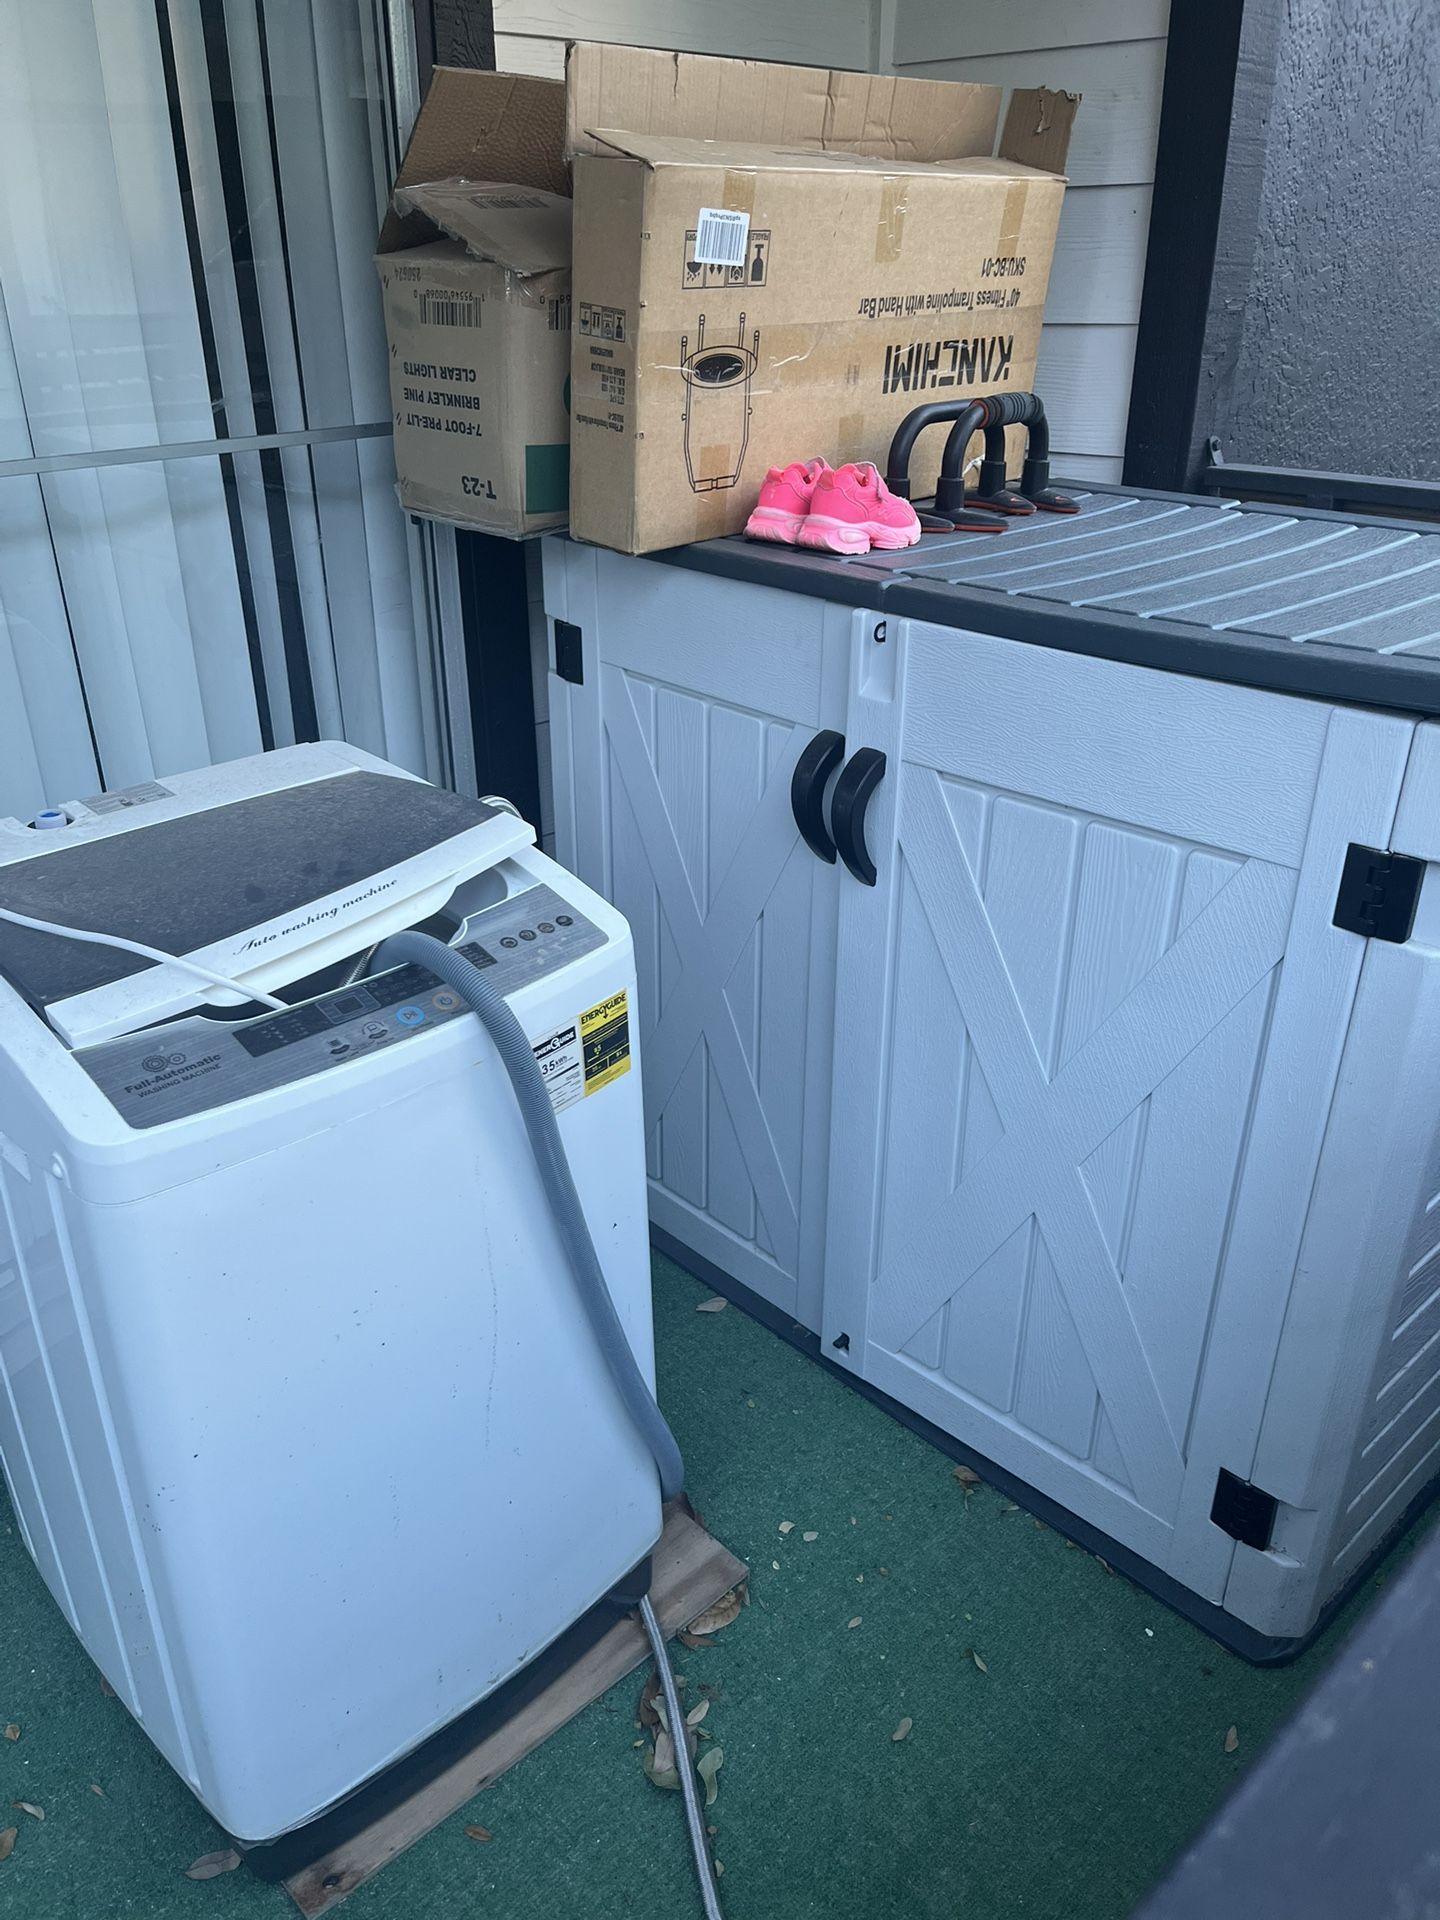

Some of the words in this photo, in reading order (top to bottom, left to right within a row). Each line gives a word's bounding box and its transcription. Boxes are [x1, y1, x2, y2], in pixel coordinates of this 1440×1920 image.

[981, 256, 1026, 277] SKU:BC-01
[858, 298, 877, 318] Bar
[878, 296, 905, 318] Hand
[905, 295, 925, 316] with
[926, 288, 975, 314] Trampoline
[976, 290, 1006, 308] Fitness
[403, 362, 437, 378] LIGHTS
[440, 366, 477, 382] CLEAR
[403, 387, 424, 402] PINE
[427, 391, 480, 410] BRINKLEY
[406, 413, 442, 430] PRE-LIT
[445, 419, 482, 437] 7-FOOT
[461, 475, 497, 500] T-23
[233, 935, 277, 955] Auto
[282, 906, 339, 936] washing
[342, 879, 398, 909] machine
[124, 1054, 222, 1093] Full-Automatic
[138, 1079, 181, 1098] WASHING
[182, 1063, 222, 1081] MACHINE
